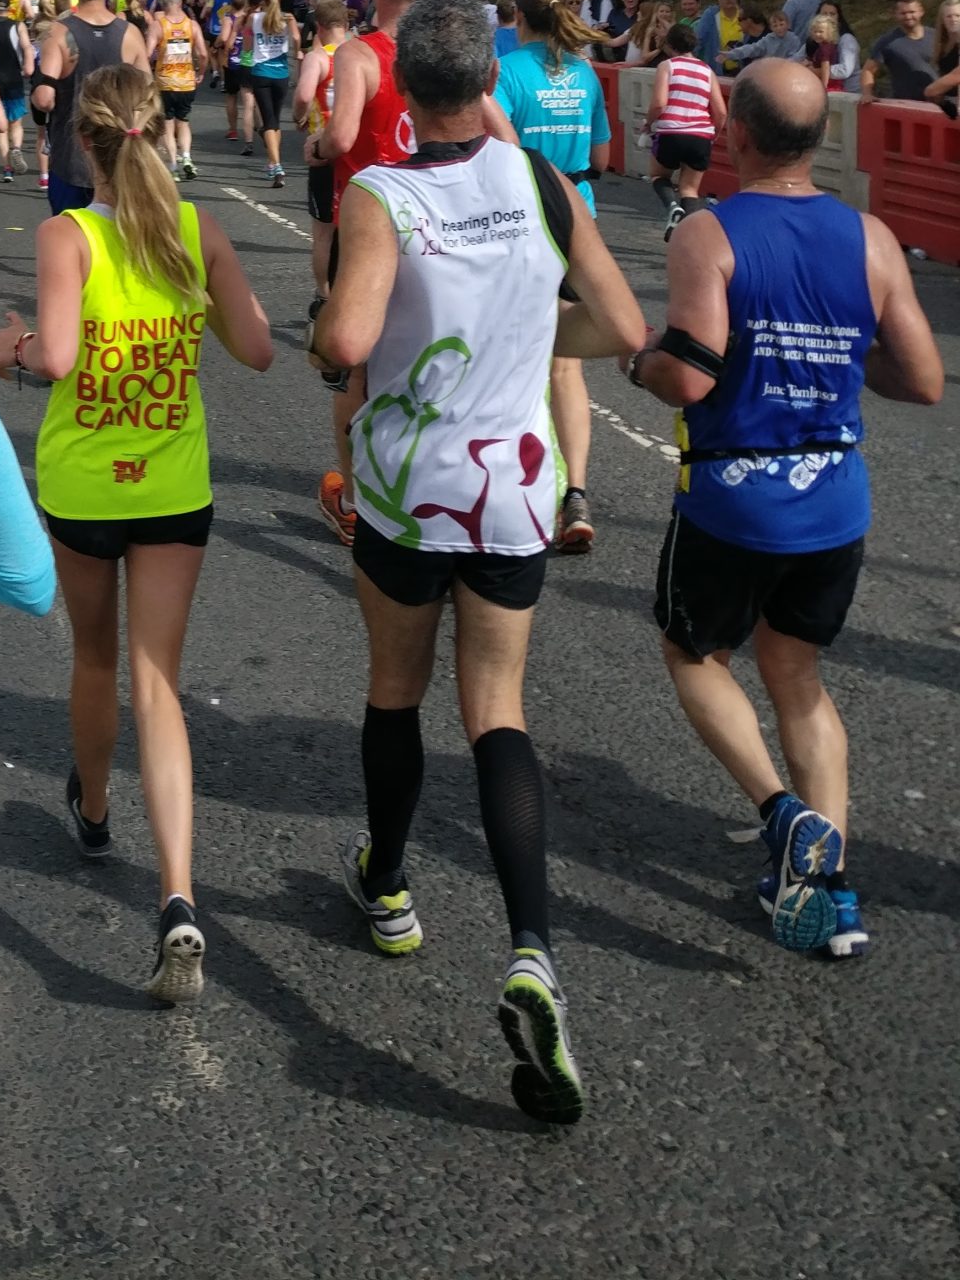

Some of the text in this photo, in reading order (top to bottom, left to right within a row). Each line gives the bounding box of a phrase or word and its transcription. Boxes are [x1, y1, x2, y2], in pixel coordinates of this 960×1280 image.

[535, 87, 587, 101] yorkshire
[541, 99, 581, 108] cancer
[441, 209, 526, 231] Hearing Dogs
[443, 236, 458, 248] for
[460, 230, 487, 247] Deaf
[84, 312, 204, 344] RUNNING
[84, 338, 201, 373] TO BEAT
[753, 347, 772, 357] AND
[761, 382, 838, 402] Jane Tomlinson
